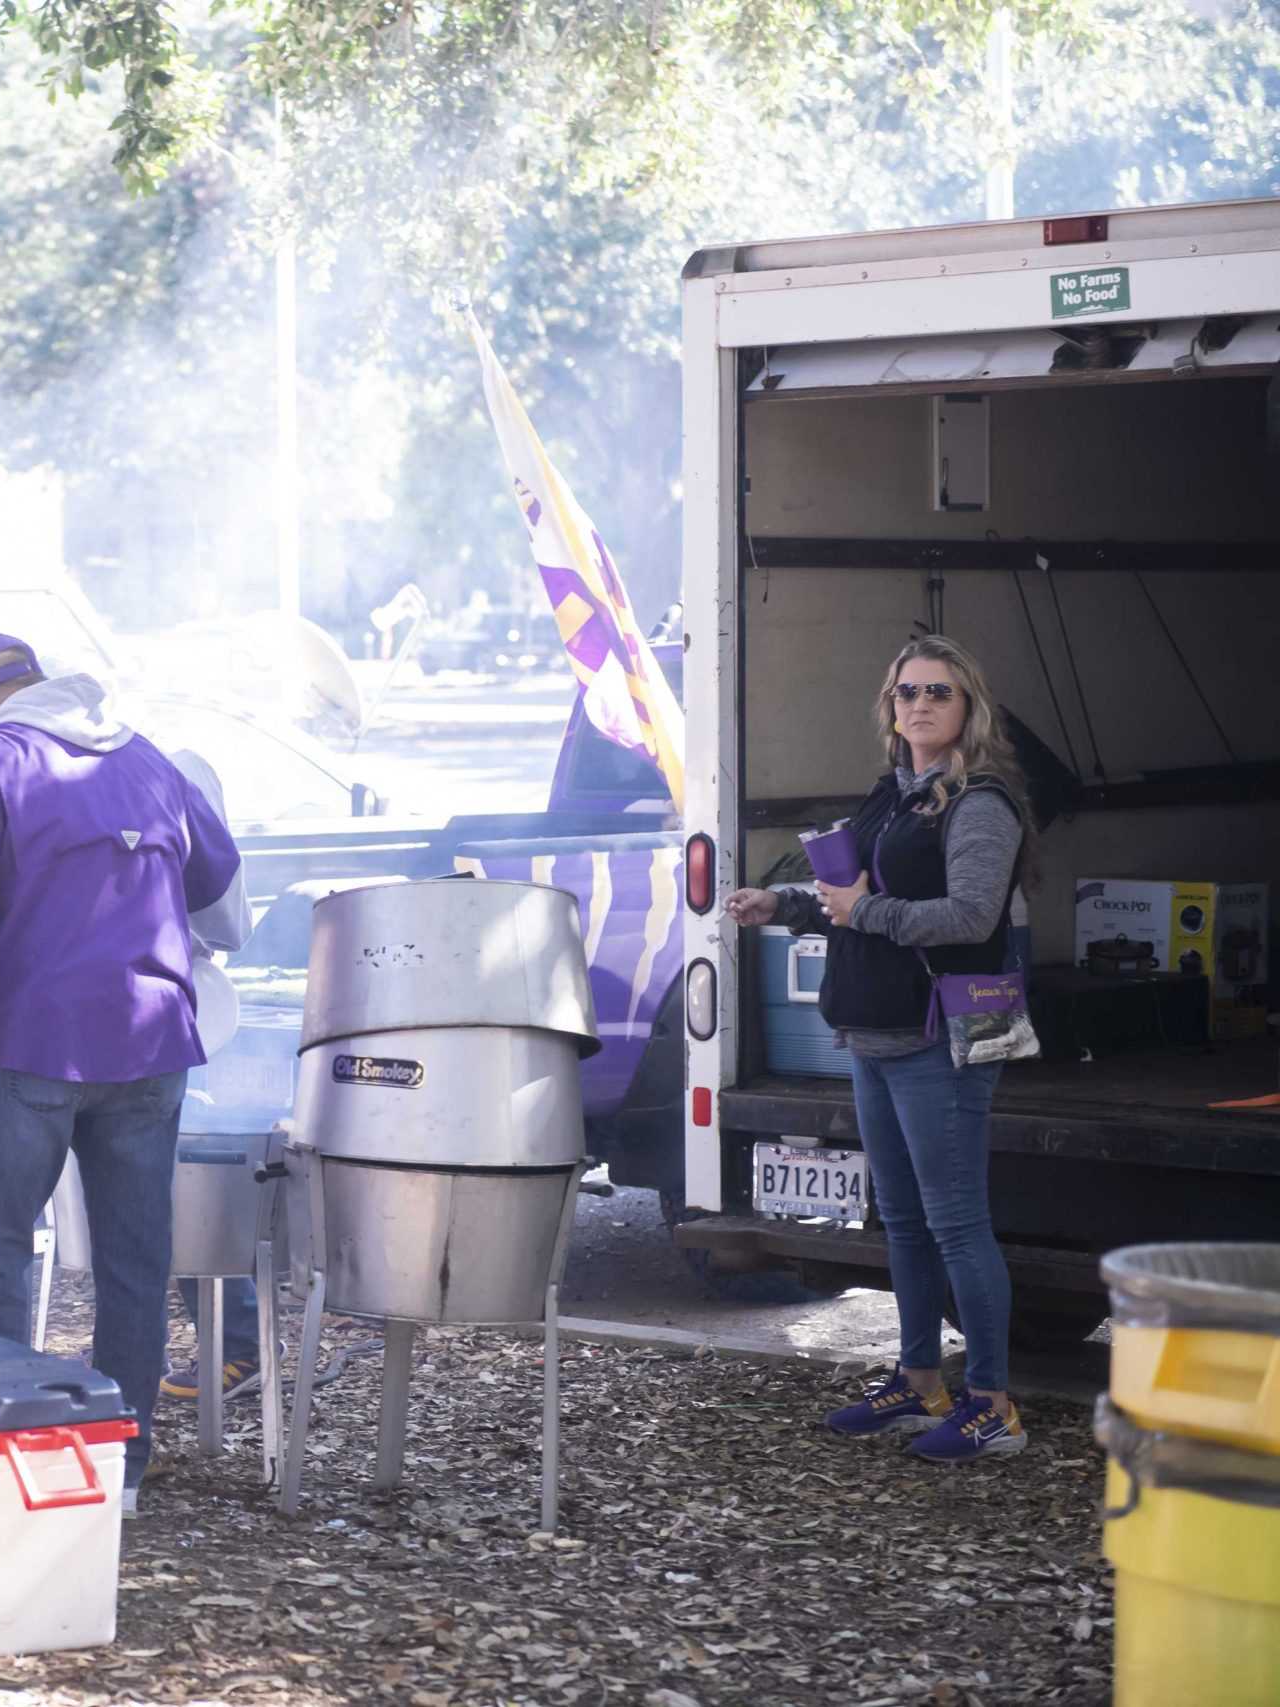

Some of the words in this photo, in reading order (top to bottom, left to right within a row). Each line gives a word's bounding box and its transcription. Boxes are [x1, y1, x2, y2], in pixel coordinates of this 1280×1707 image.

[1058, 277, 1077, 291] No
[1080, 272, 1121, 288] Farms
[1063, 291, 1081, 306] No
[1085, 285, 1118, 303] Food
[334, 1057, 360, 1077] Old
[361, 1058, 422, 1085] Smokey
[763, 1164, 861, 1201] B712134
